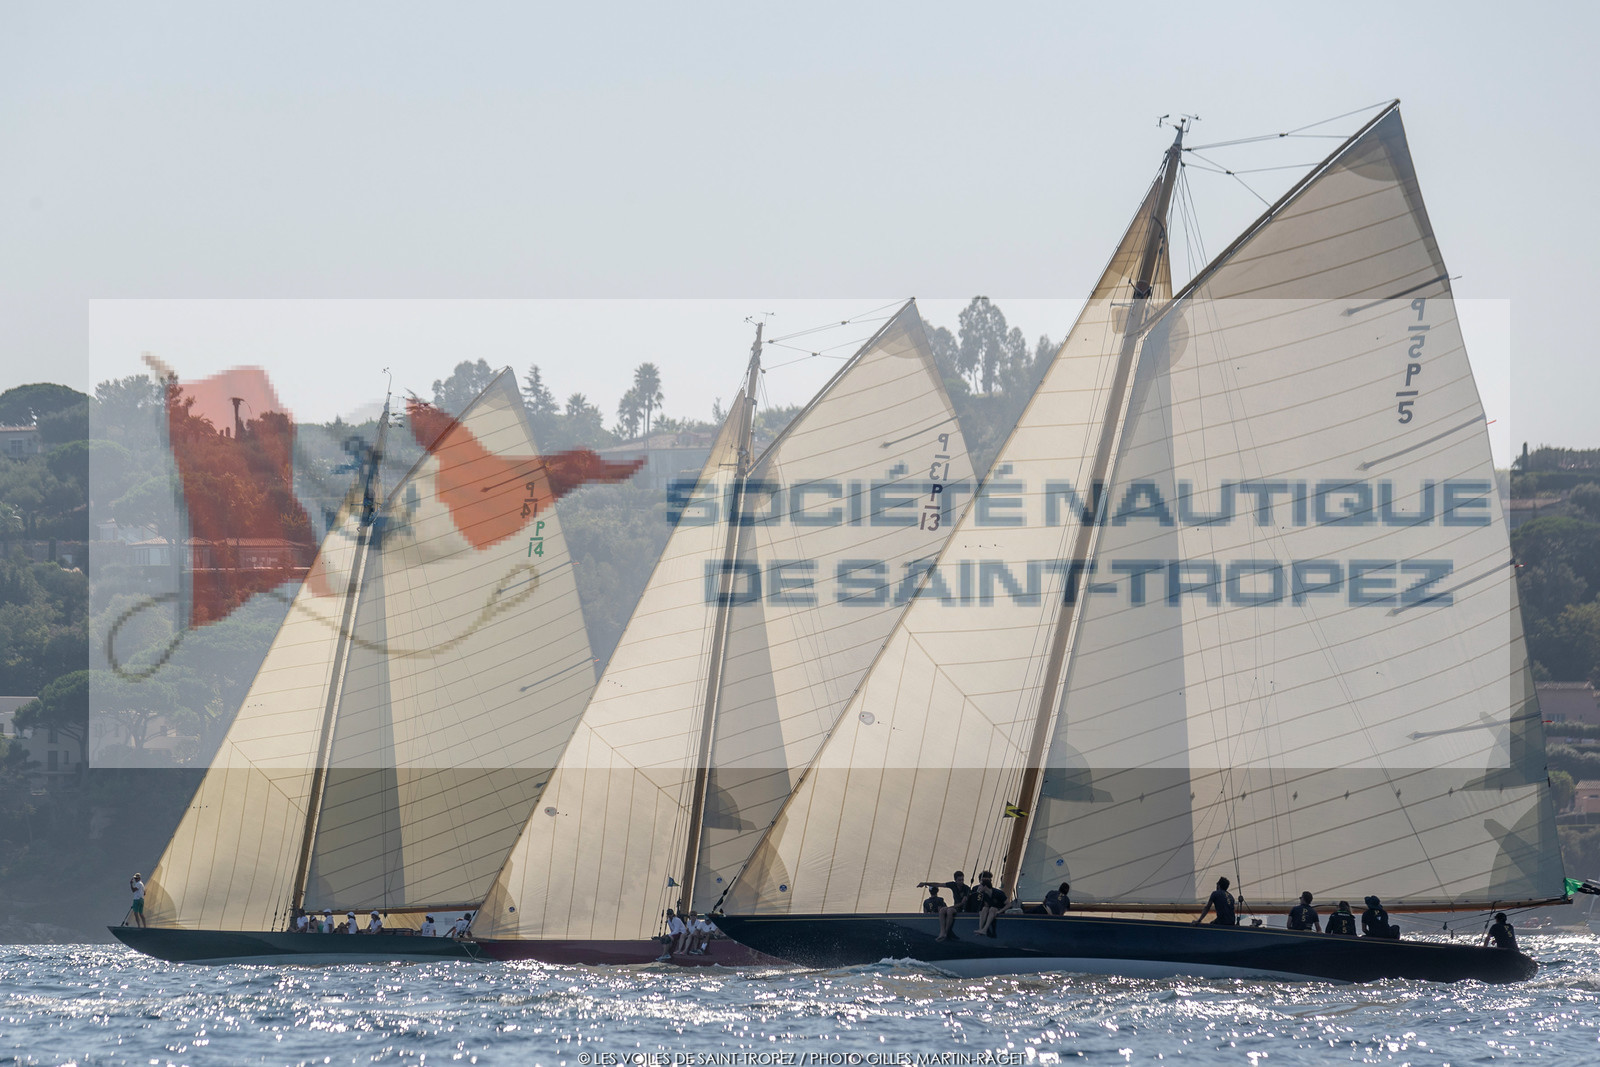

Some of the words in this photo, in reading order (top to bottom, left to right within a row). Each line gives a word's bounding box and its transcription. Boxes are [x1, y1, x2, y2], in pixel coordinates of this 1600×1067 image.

[1405, 363, 1421, 387] P
[1398, 401, 1414, 424] 5
[930, 483, 943, 502] P
[535, 521, 545, 536] P
[920, 512, 941, 531] 13
[527, 542, 544, 557] 14
